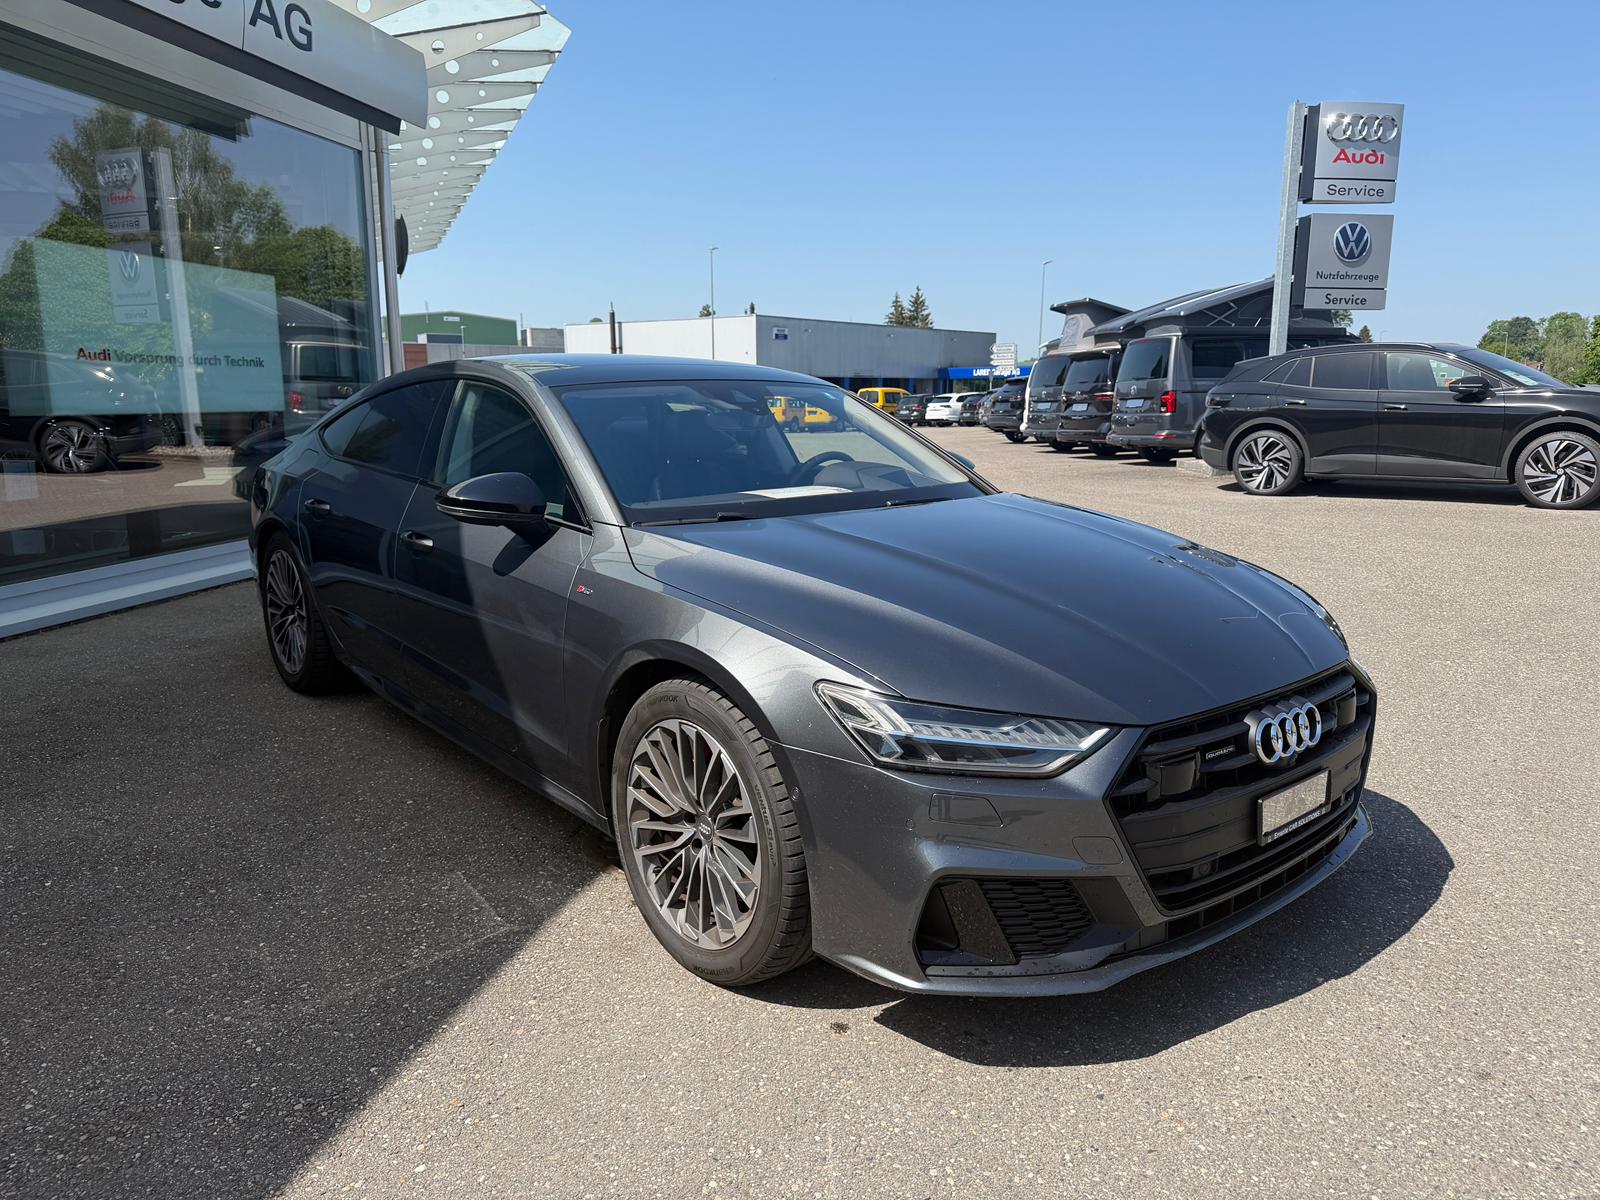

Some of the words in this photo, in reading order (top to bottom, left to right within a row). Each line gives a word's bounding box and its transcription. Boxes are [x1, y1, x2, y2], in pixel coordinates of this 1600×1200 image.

[249, 0, 313, 52] AG
[1333, 148, 1384, 165] Audi
[1326, 184, 1385, 198] Service
[1316, 271, 1379, 282] Nutzfahrzeuge
[1324, 293, 1367, 306] Service
[76, 347, 112, 362] Audi
[114, 350, 184, 367] Vorsprung
[188, 353, 221, 367] durch
[224, 355, 265, 368] Technik
